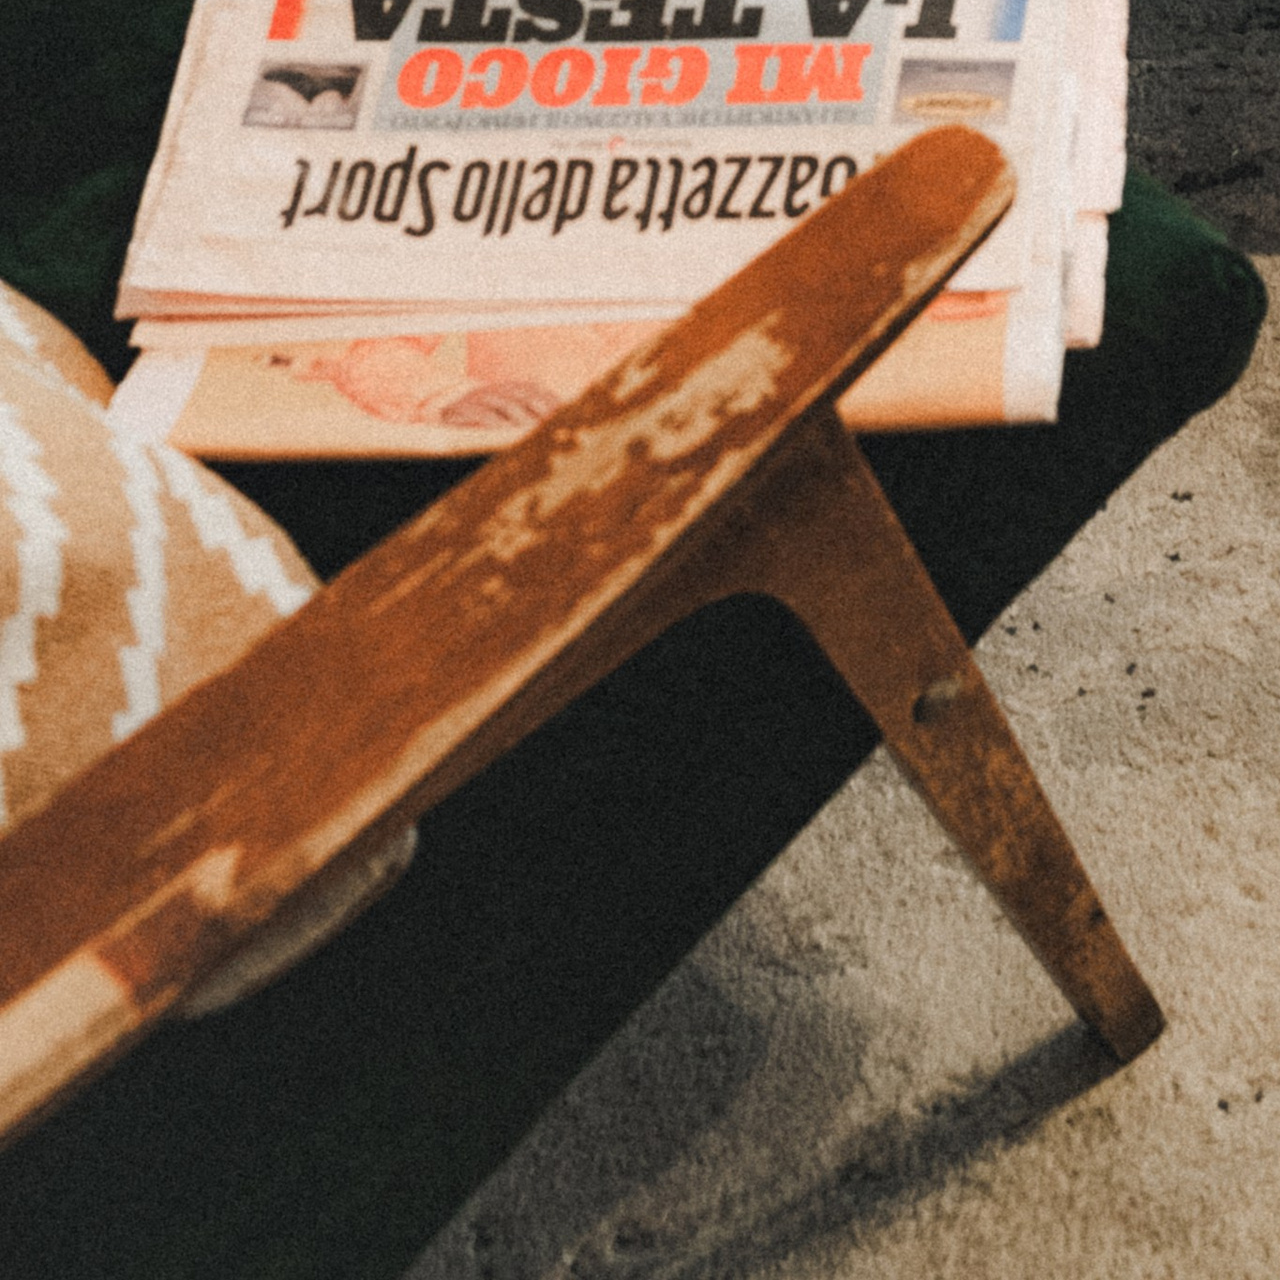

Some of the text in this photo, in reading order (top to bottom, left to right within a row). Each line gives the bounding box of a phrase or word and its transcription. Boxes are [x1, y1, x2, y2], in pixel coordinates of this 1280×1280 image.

[399, 44, 872, 109] MI GIOCO
[282, 145, 451, 237] Sport
[452, 158, 595, 236] dello
